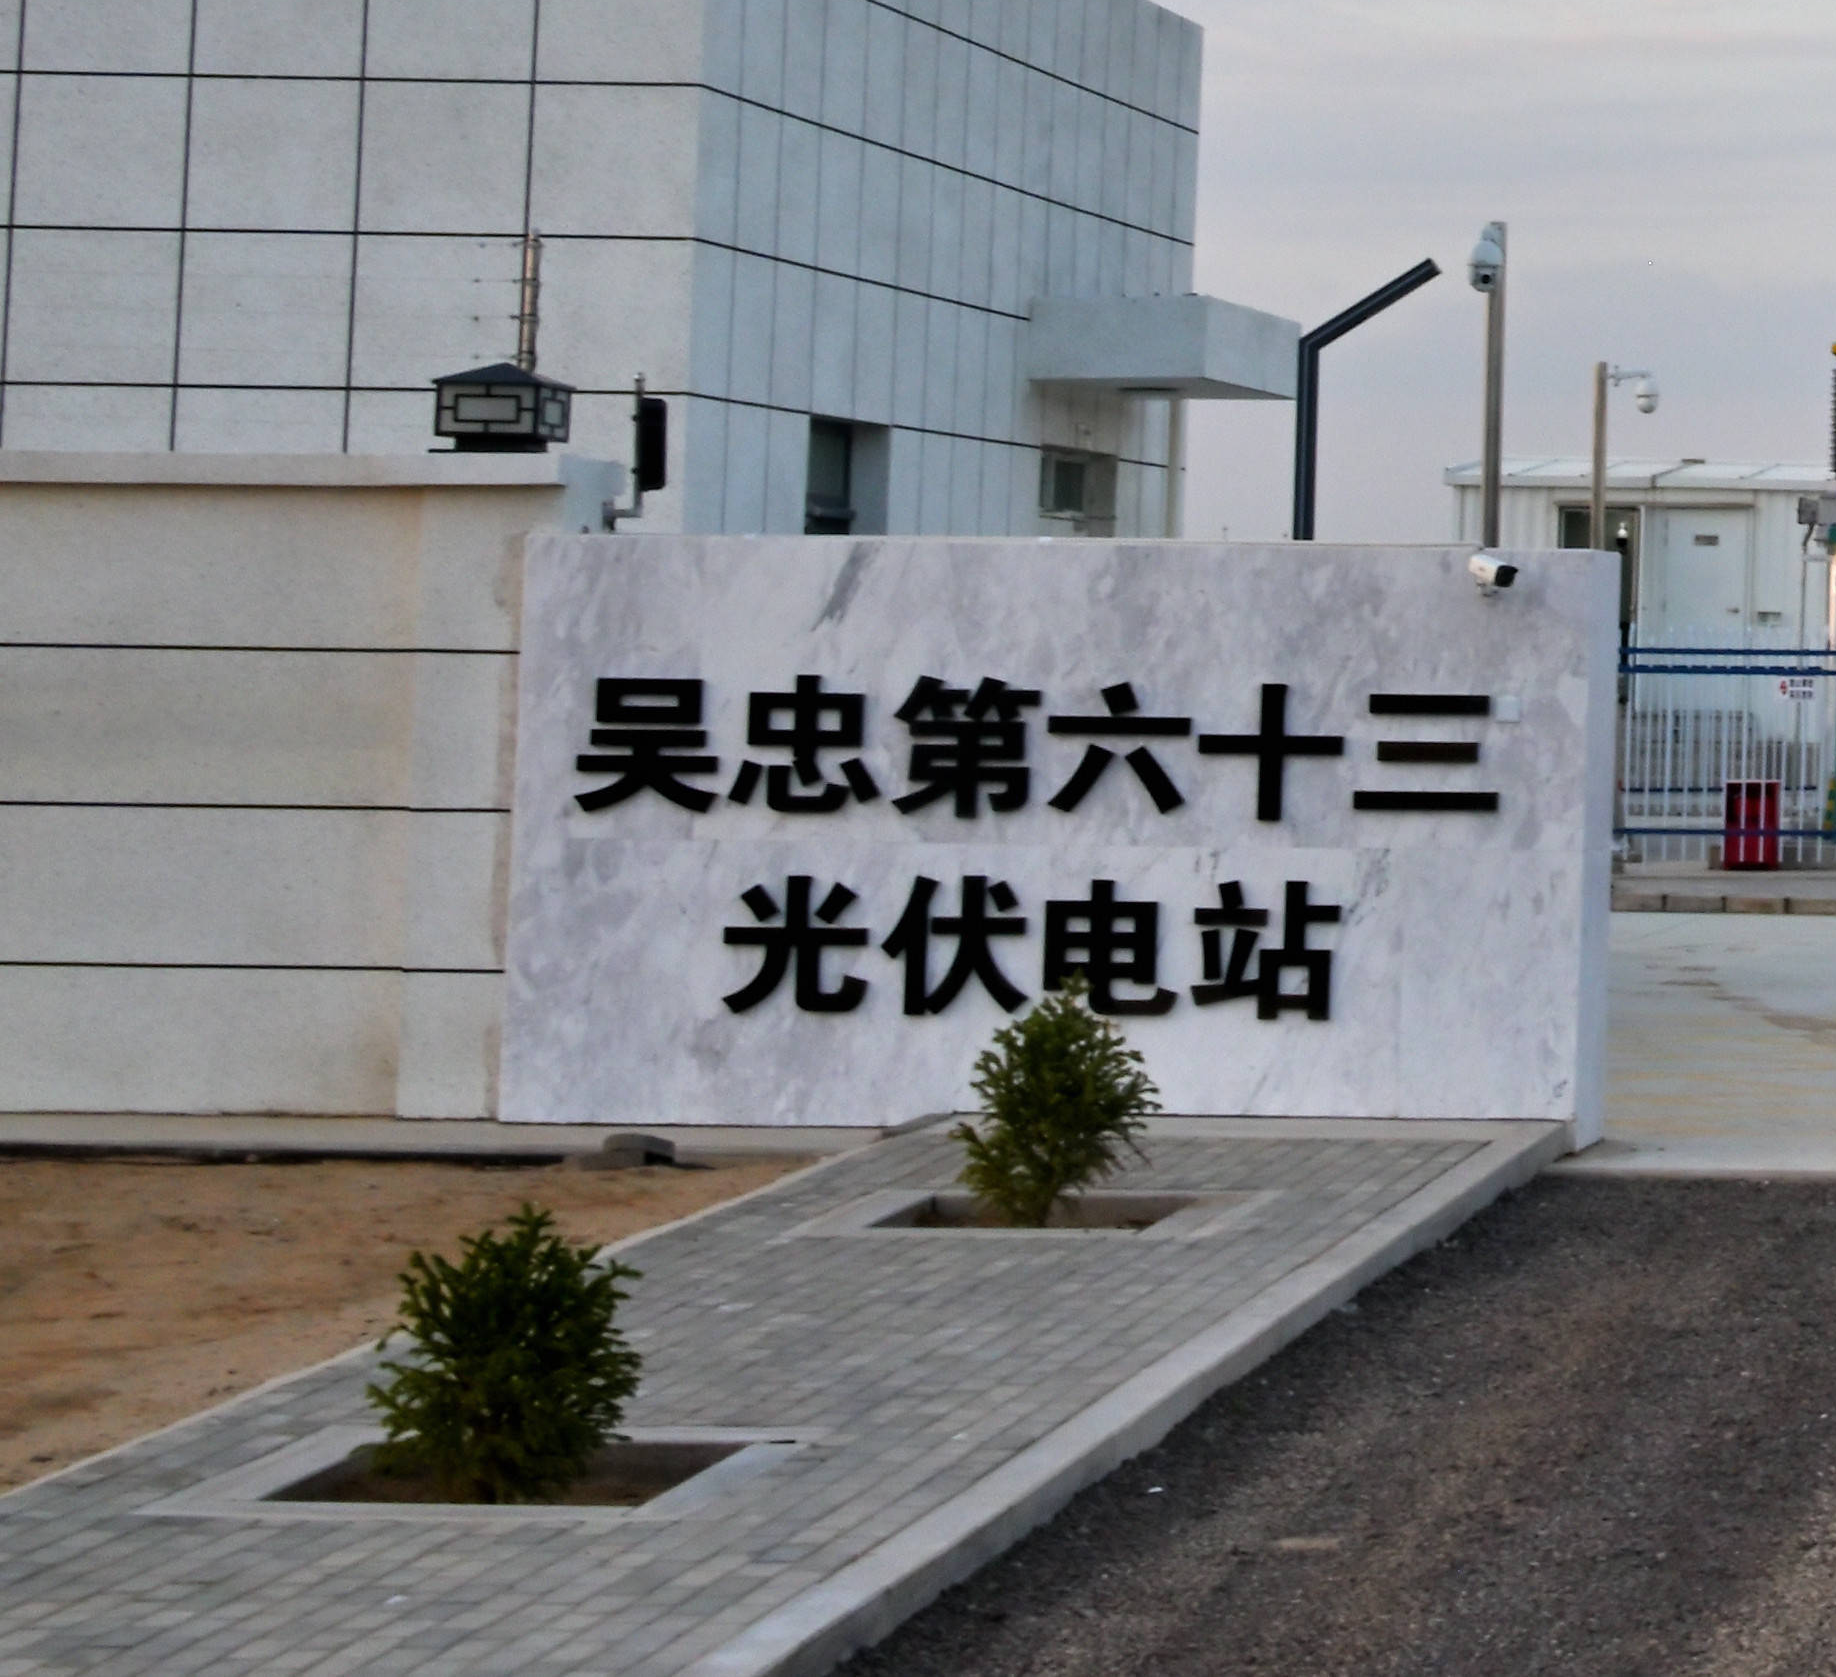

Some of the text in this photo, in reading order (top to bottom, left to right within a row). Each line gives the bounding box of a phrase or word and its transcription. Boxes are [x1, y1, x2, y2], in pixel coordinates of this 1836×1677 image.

[574, 675, 1501, 822] 吴忠第六十三
[723, 875, 1342, 1021] 光伏电站
